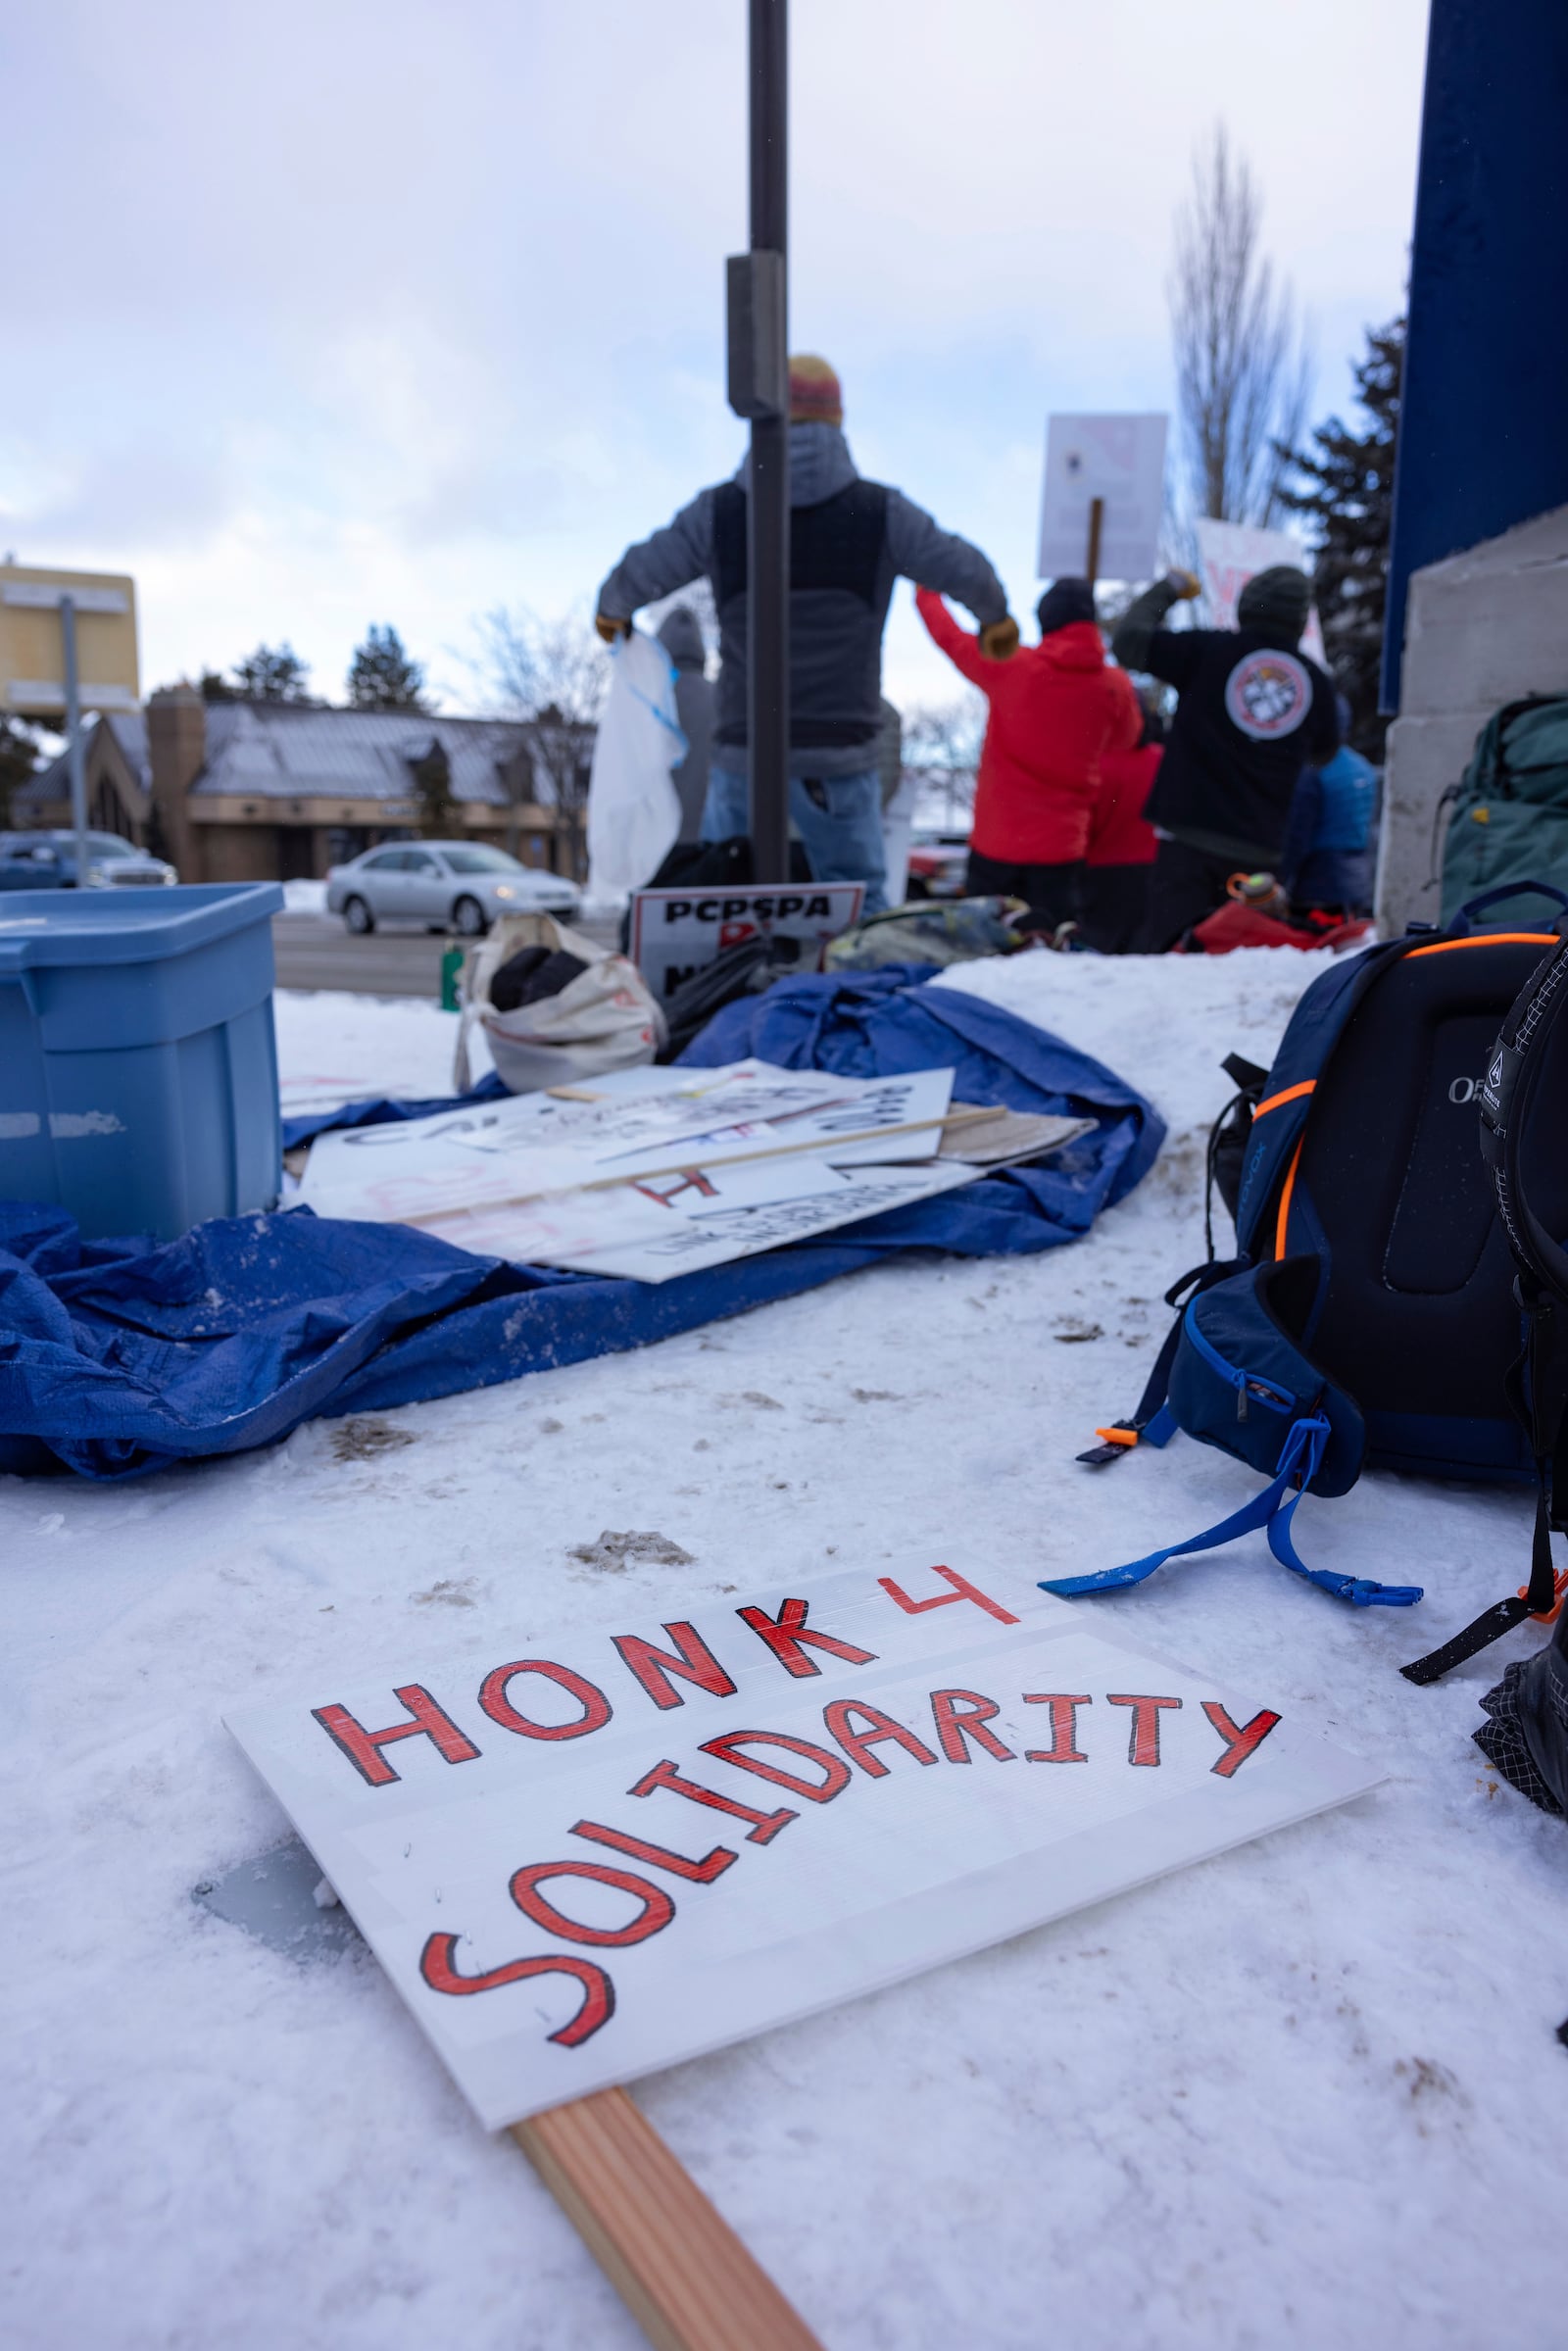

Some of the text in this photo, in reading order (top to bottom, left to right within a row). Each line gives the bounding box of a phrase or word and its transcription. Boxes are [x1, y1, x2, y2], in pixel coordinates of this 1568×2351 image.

[665, 896, 830, 923] PCPSPA
[311, 1565, 1021, 1786] HONK 4
[420, 1690, 1283, 2047] SOLIDARITY
